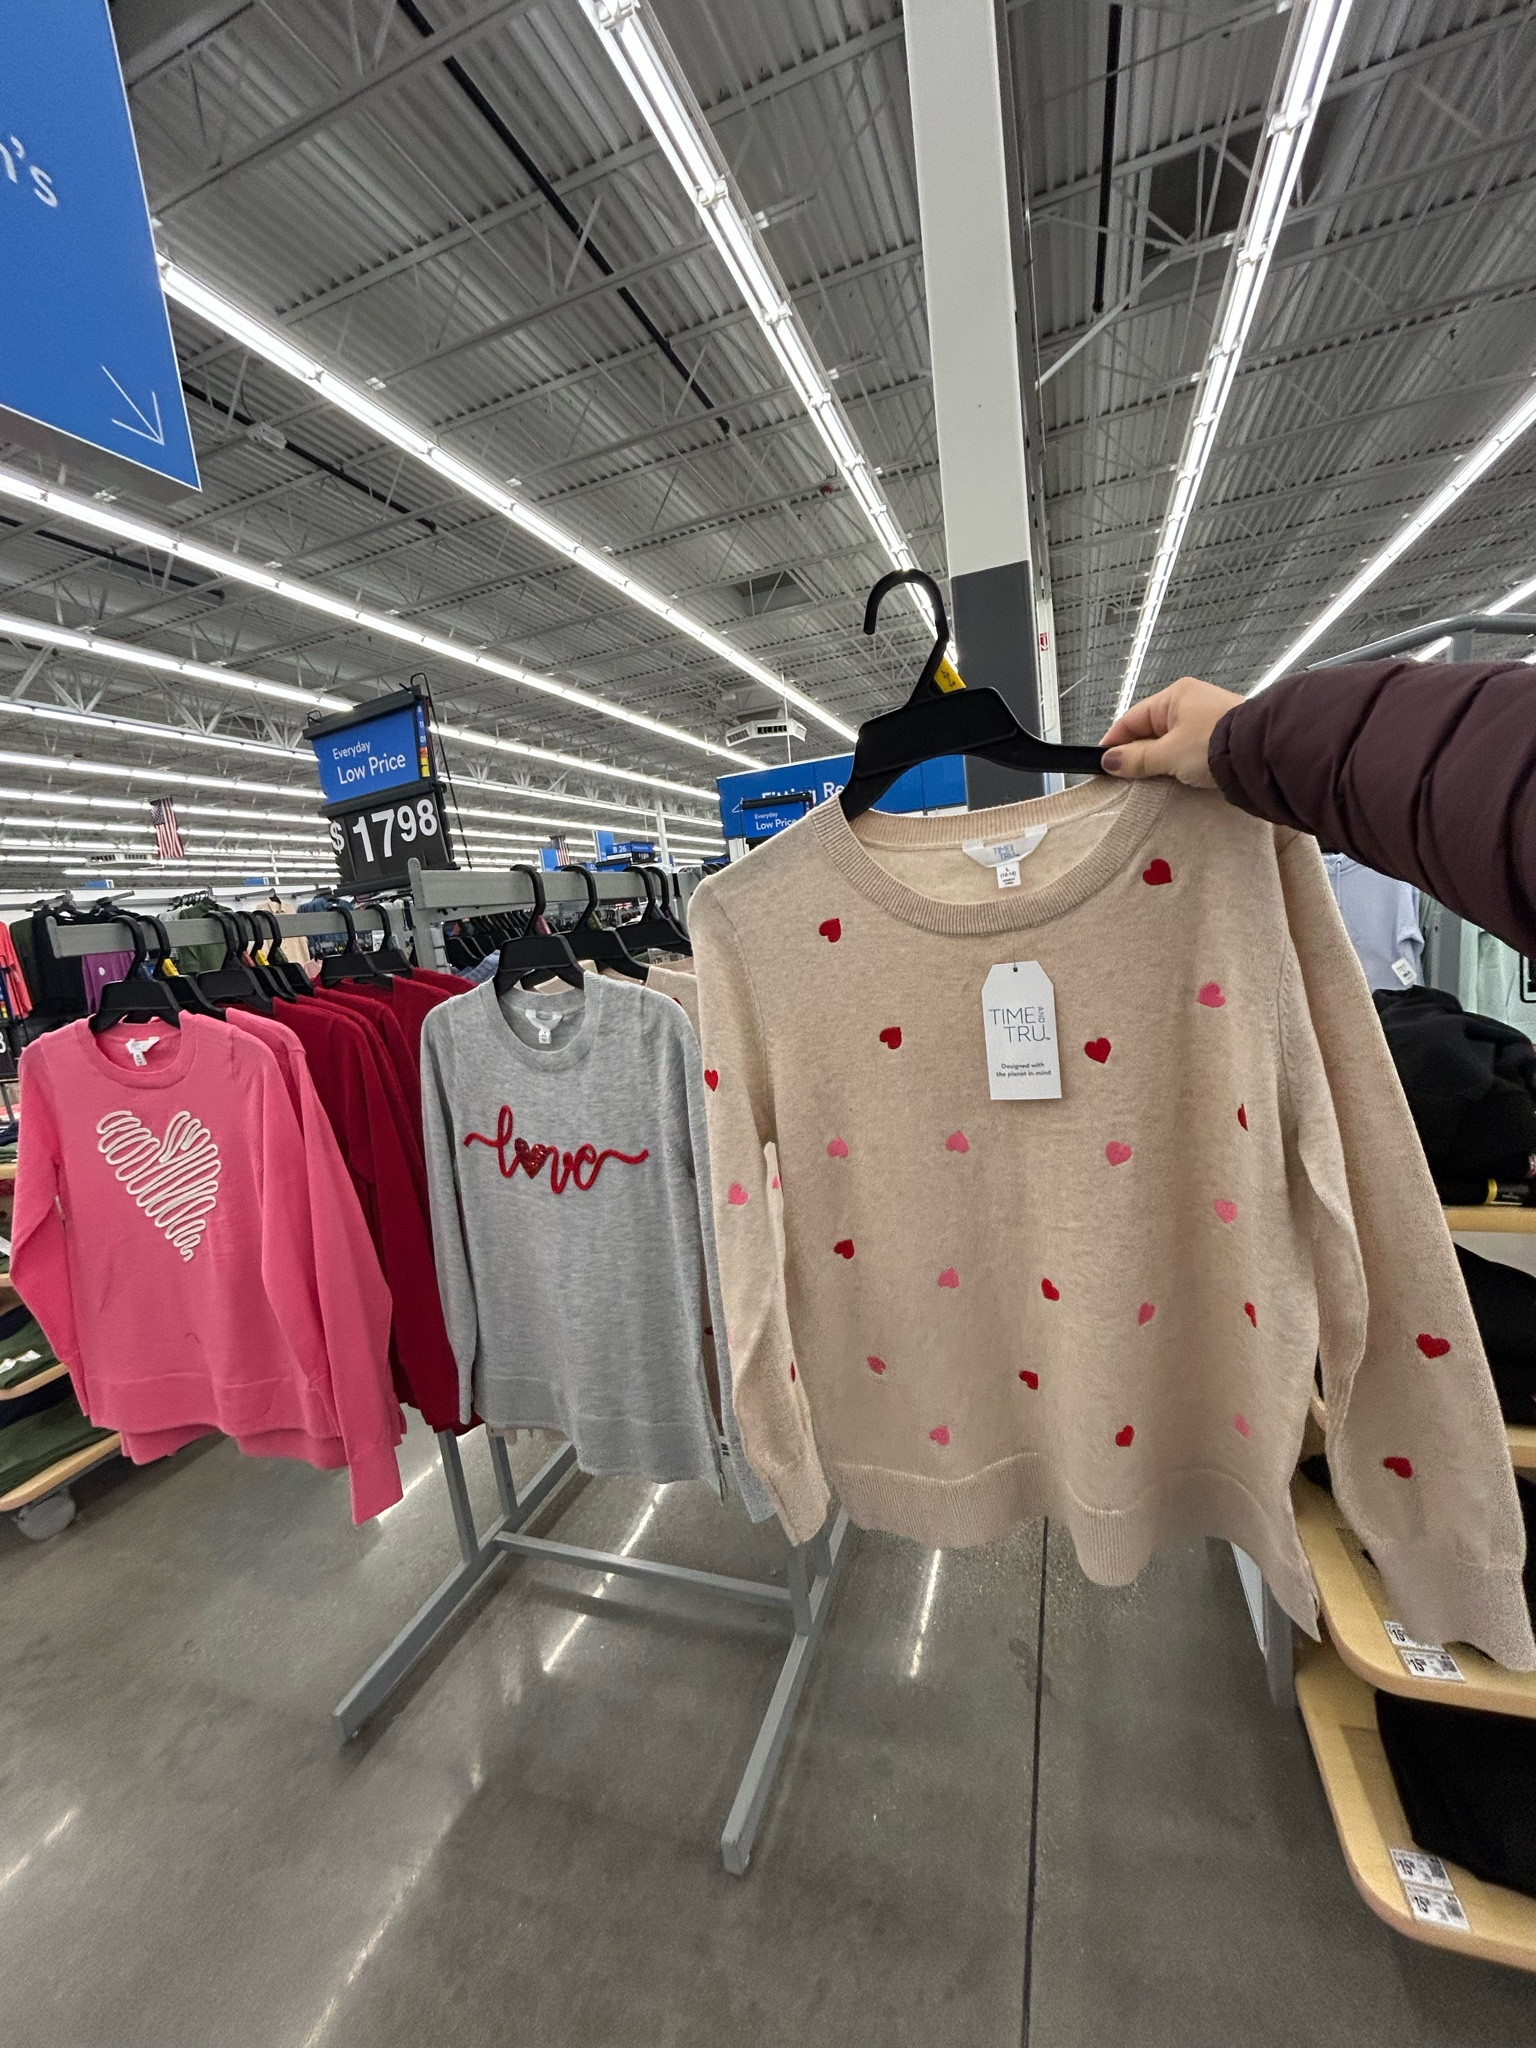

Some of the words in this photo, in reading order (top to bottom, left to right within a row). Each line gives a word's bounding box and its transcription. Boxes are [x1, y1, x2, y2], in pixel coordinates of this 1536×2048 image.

[332, 741, 371, 760] Everyday
[337, 765, 366, 785] Low
[368, 753, 406, 777] Price
[754, 812, 778, 821] Everyday
[755, 821, 773, 831] Low
[989, 1006, 1037, 1025] TIME
[1037, 1006, 1046, 1024] AND
[1003, 1025, 1046, 1043] TRU
[1001, 1062, 1030, 1070] Designed
[1008, 1070, 1027, 1078] planet
